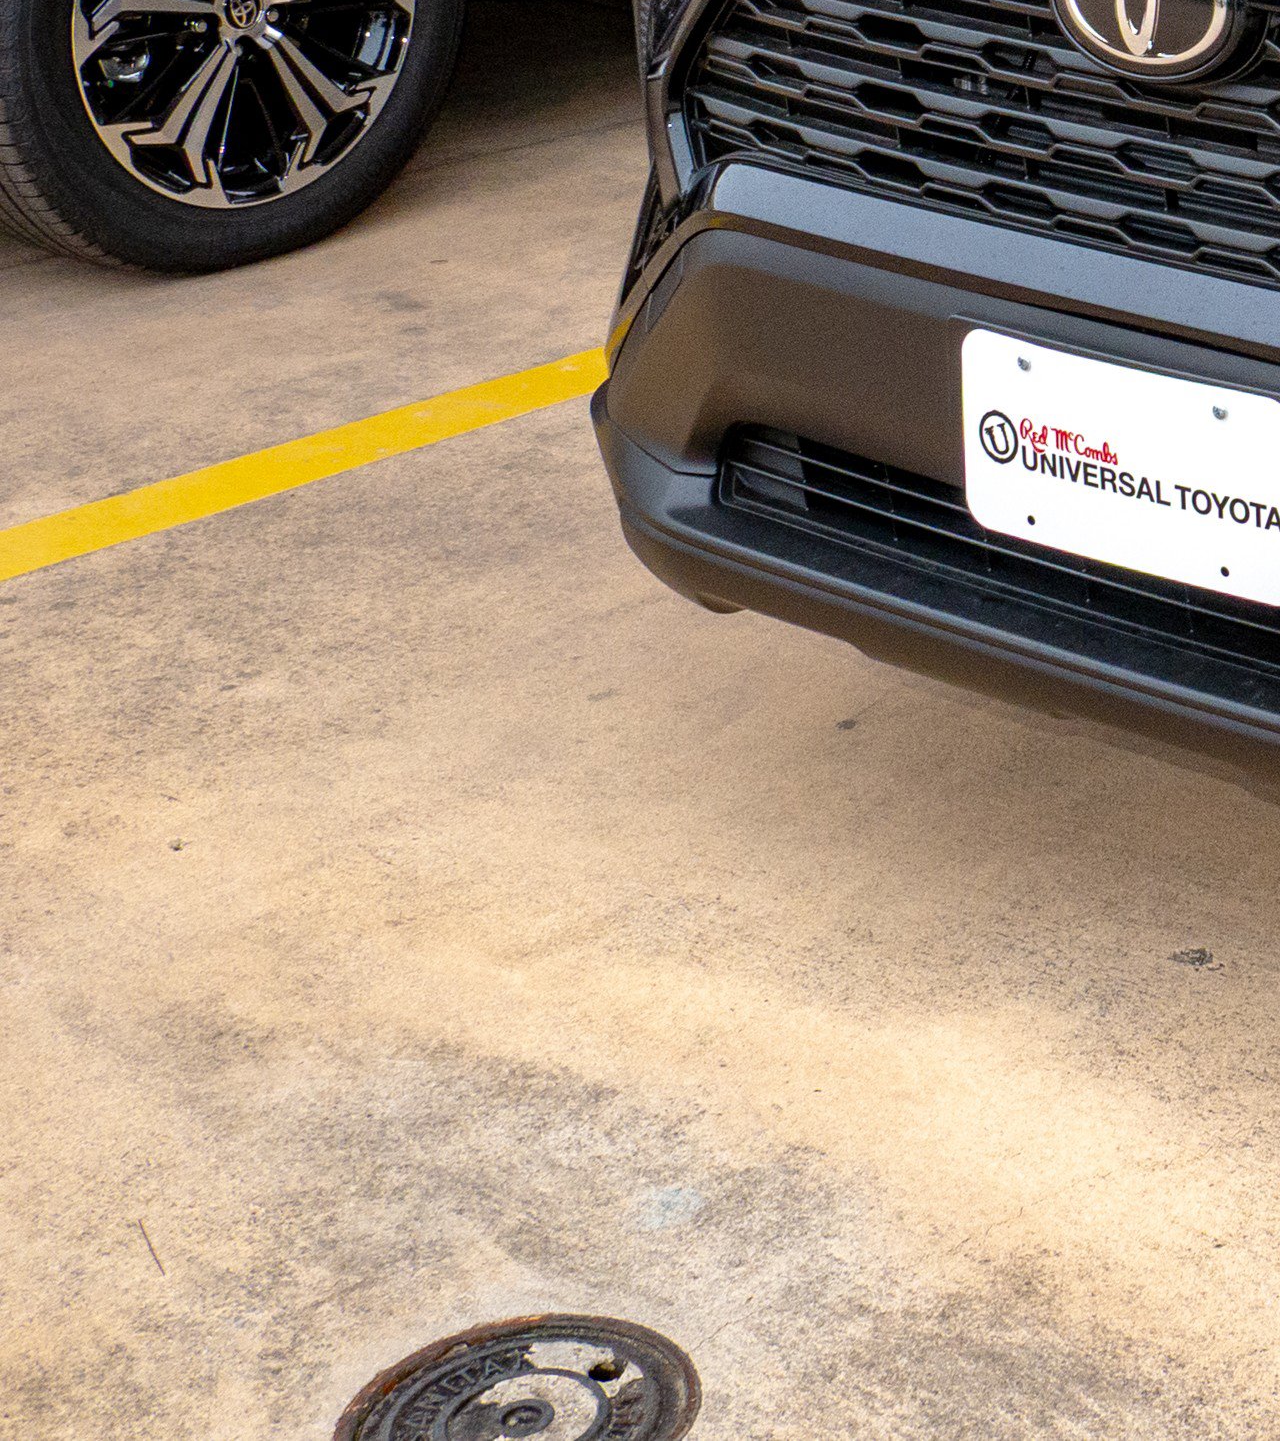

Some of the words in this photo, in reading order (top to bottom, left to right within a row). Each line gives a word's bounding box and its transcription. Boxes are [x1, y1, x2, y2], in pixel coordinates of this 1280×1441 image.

[1020, 418, 1048, 453] Red
[1051, 427, 1119, 466] McCombs
[1021, 445, 1171, 506] UNIVERSAL
